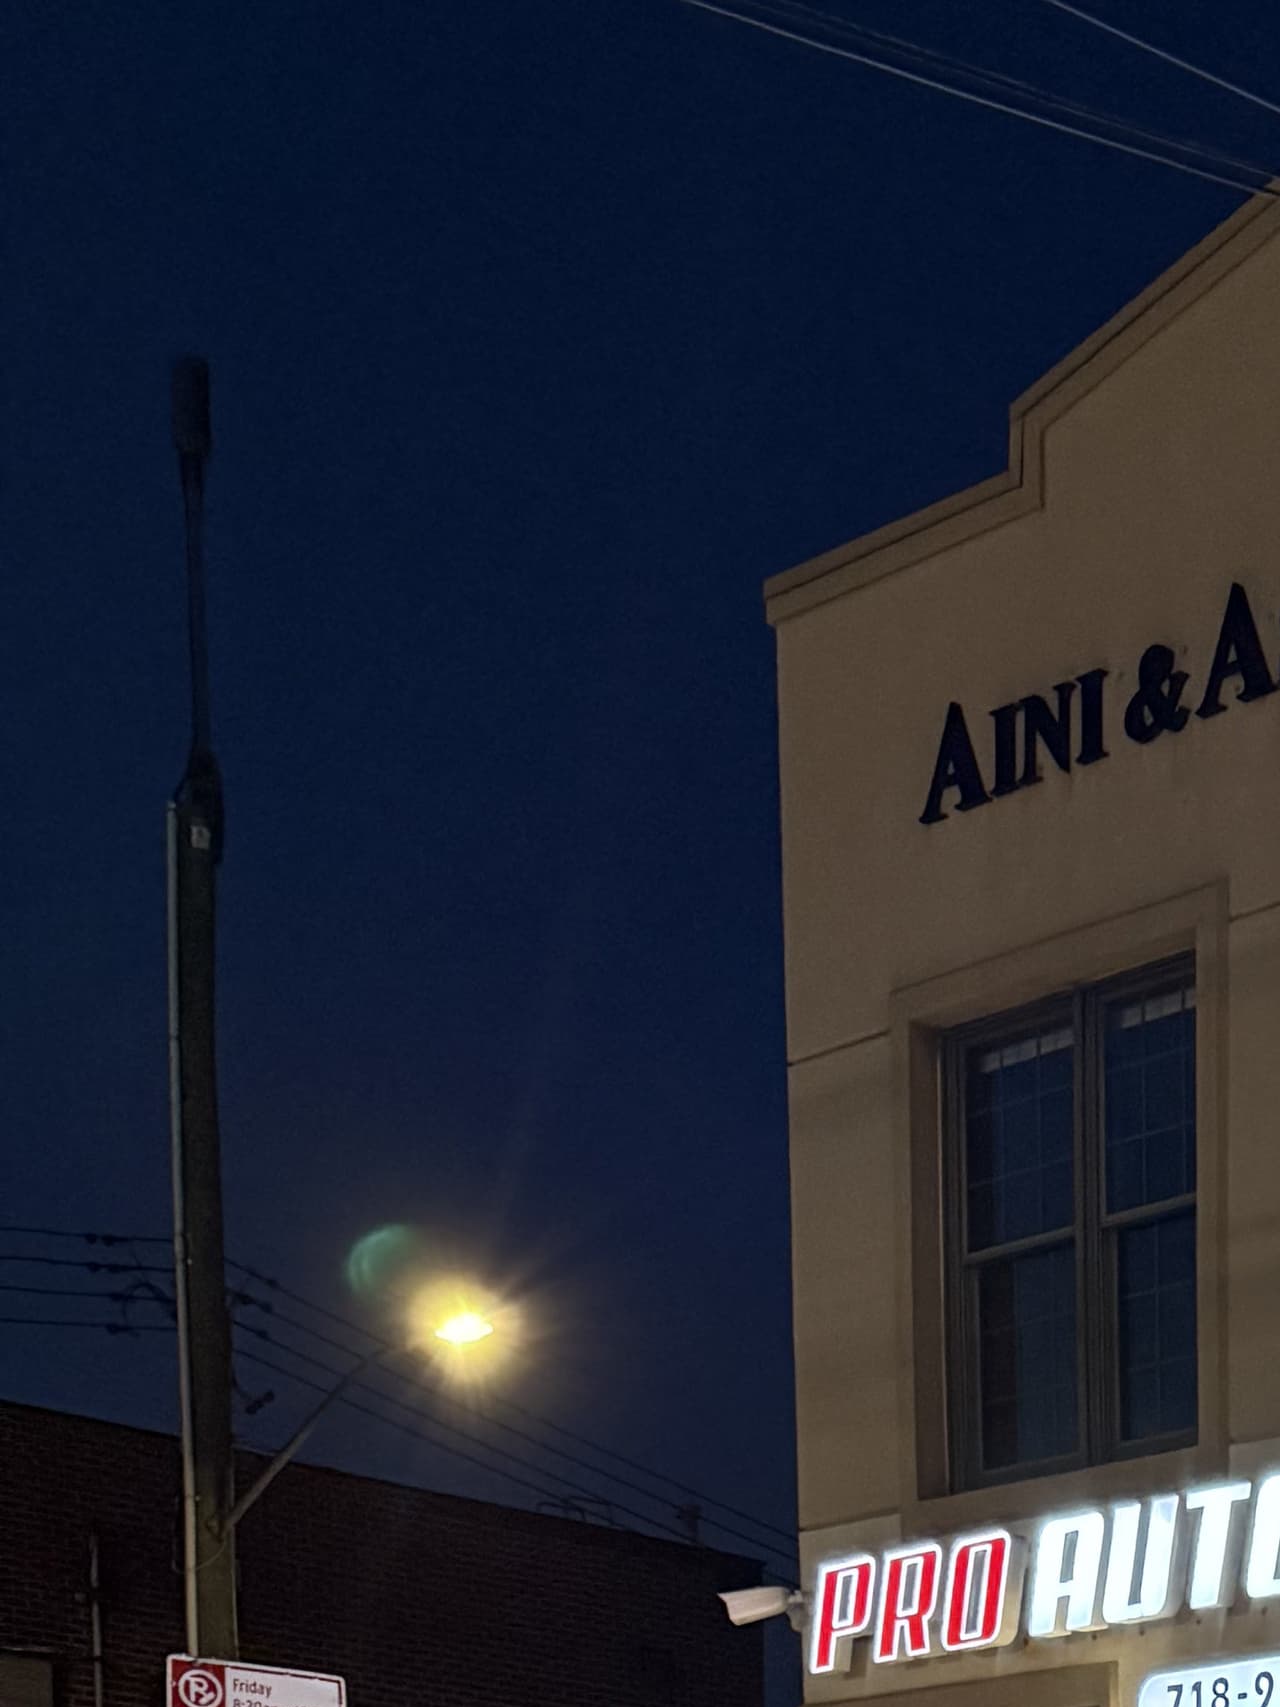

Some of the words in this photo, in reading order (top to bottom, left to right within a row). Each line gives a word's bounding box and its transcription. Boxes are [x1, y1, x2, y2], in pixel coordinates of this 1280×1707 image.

[919, 667, 1109, 825] AINI
[1124, 644, 1191, 744] &
[810, 1528, 1012, 1675] PRO
[232, 1678, 272, 1698] Friday
